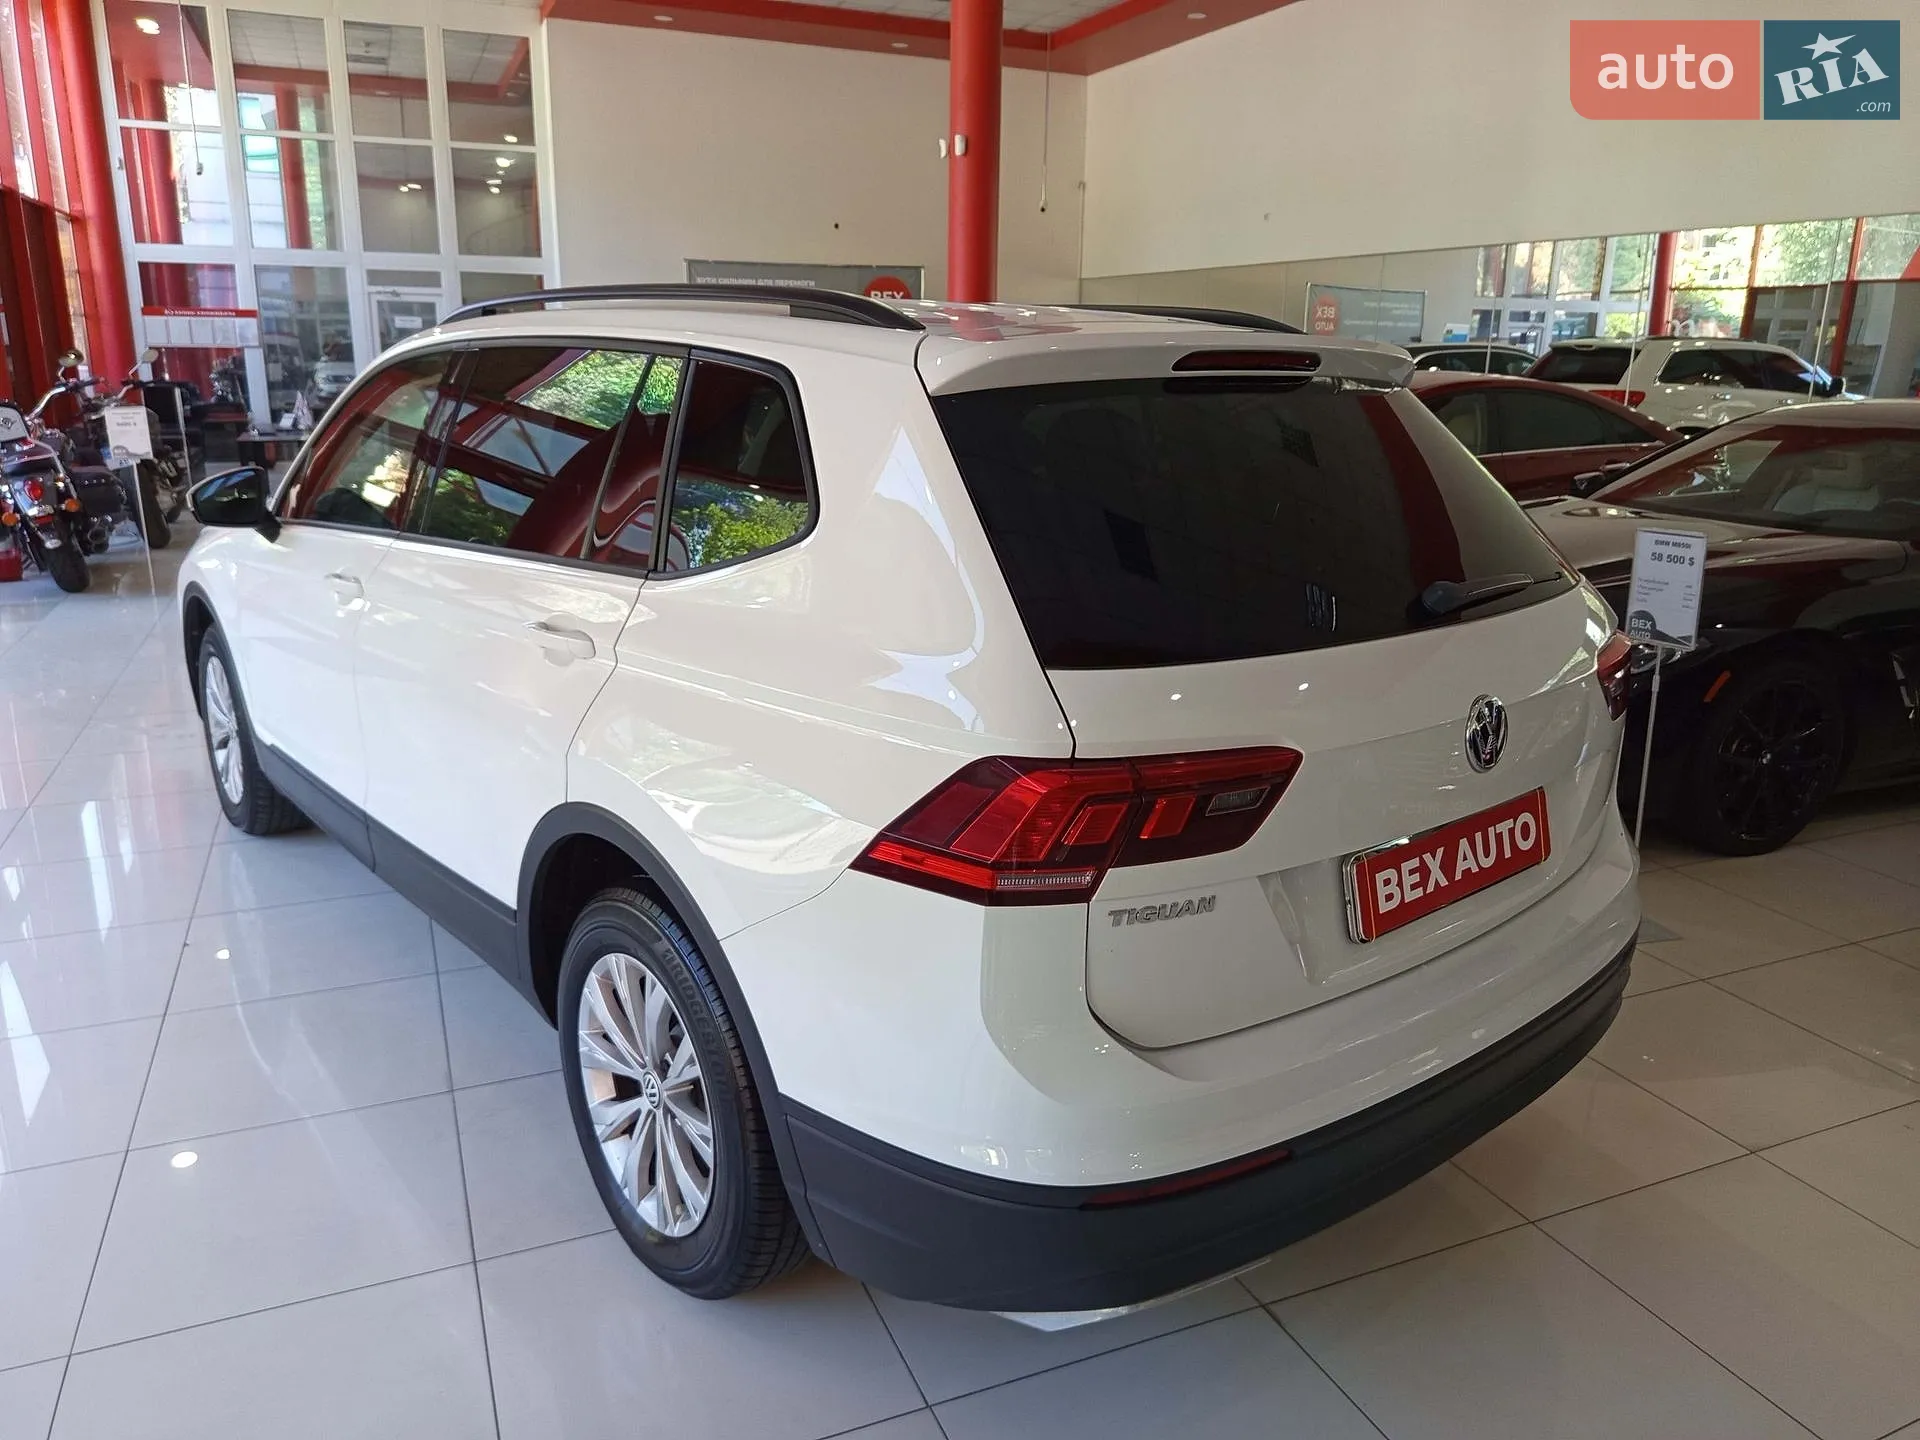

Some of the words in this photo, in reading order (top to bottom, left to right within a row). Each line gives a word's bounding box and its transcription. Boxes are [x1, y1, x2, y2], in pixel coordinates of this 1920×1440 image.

[1650, 551, 1663, 562] 58
[1666, 553, 1685, 565] 500
[1631, 618, 1653, 630] BEX
[1630, 630, 1651, 639] AUTO
[1375, 847, 1449, 914] BEX
[1454, 812, 1536, 881] AUTO
[1108, 895, 1216, 927] TIGUAN
